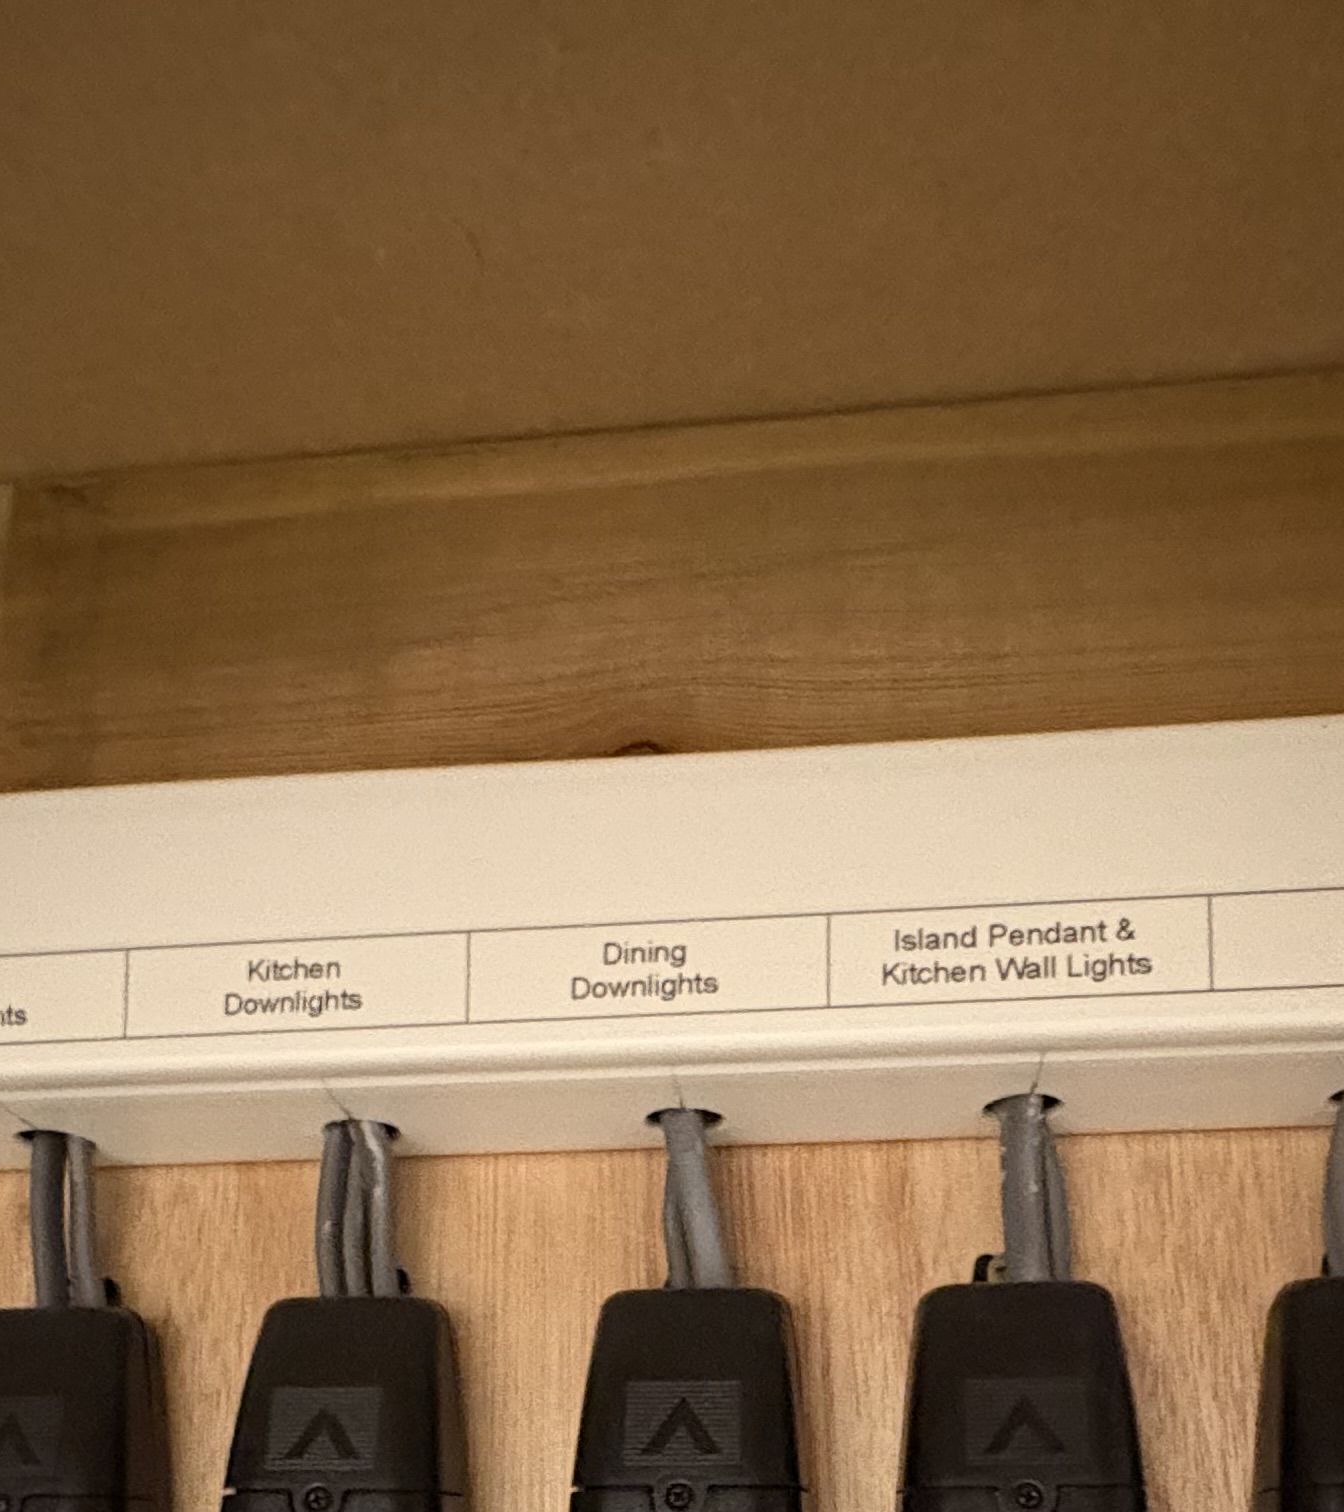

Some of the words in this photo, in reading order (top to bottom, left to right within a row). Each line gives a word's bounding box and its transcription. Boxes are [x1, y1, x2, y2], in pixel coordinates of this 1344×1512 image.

[893, 926, 977, 952] Island
[988, 921, 1107, 948] Pendant
[1116, 918, 1136, 942] &
[602, 940, 687, 968] Dining
[247, 957, 341, 982] Kitchen
[881, 958, 986, 985] Kitchen
[995, 956, 1057, 981] Wall
[1066, 953, 1153, 981] Lights
[570, 972, 719, 1001] Downlights
[223, 989, 363, 1016] Downlights
